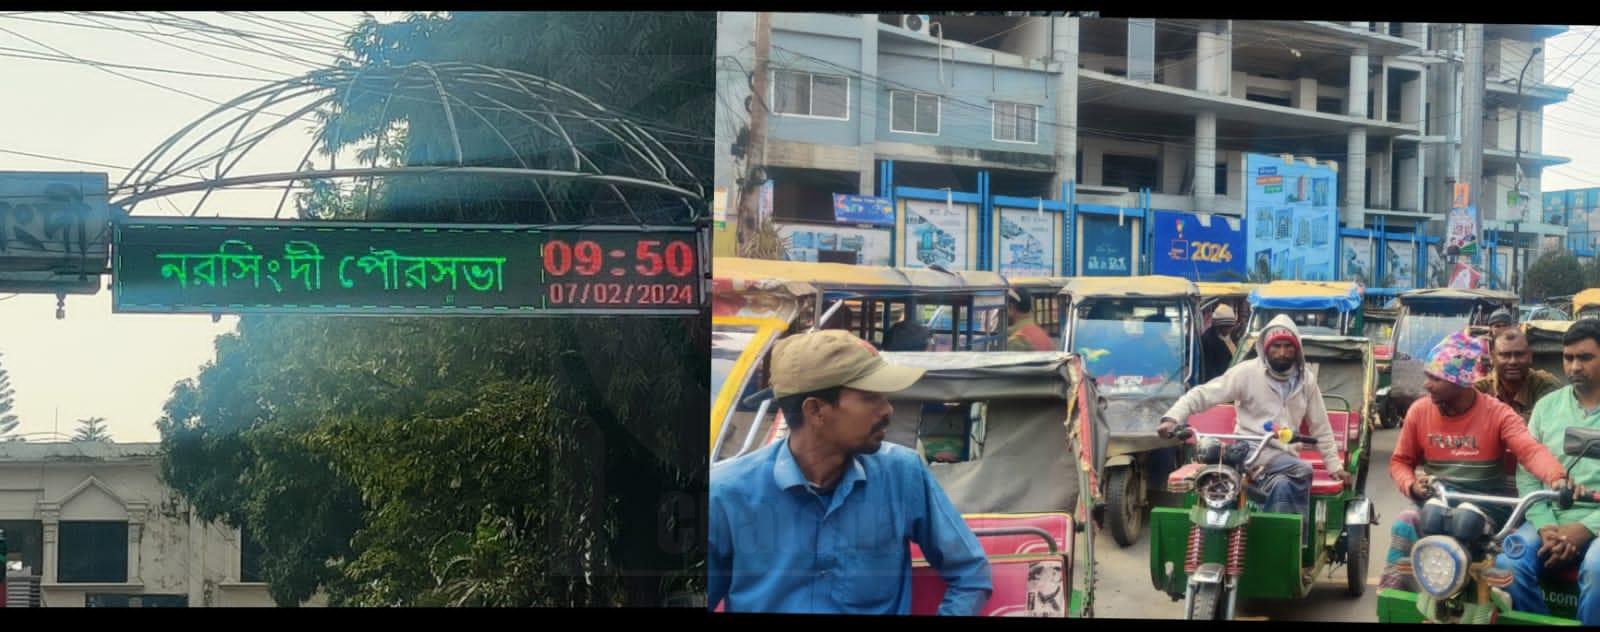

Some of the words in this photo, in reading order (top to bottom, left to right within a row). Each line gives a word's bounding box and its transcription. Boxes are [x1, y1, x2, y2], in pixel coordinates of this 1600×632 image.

[156, 239, 325, 292] নরসিংদী
[338, 247, 506, 291] পৌরসভা
[543, 240, 693, 277] 09:50
[1190, 241, 1233, 263] 2024
[550, 283, 692, 304] 07/02/2024
